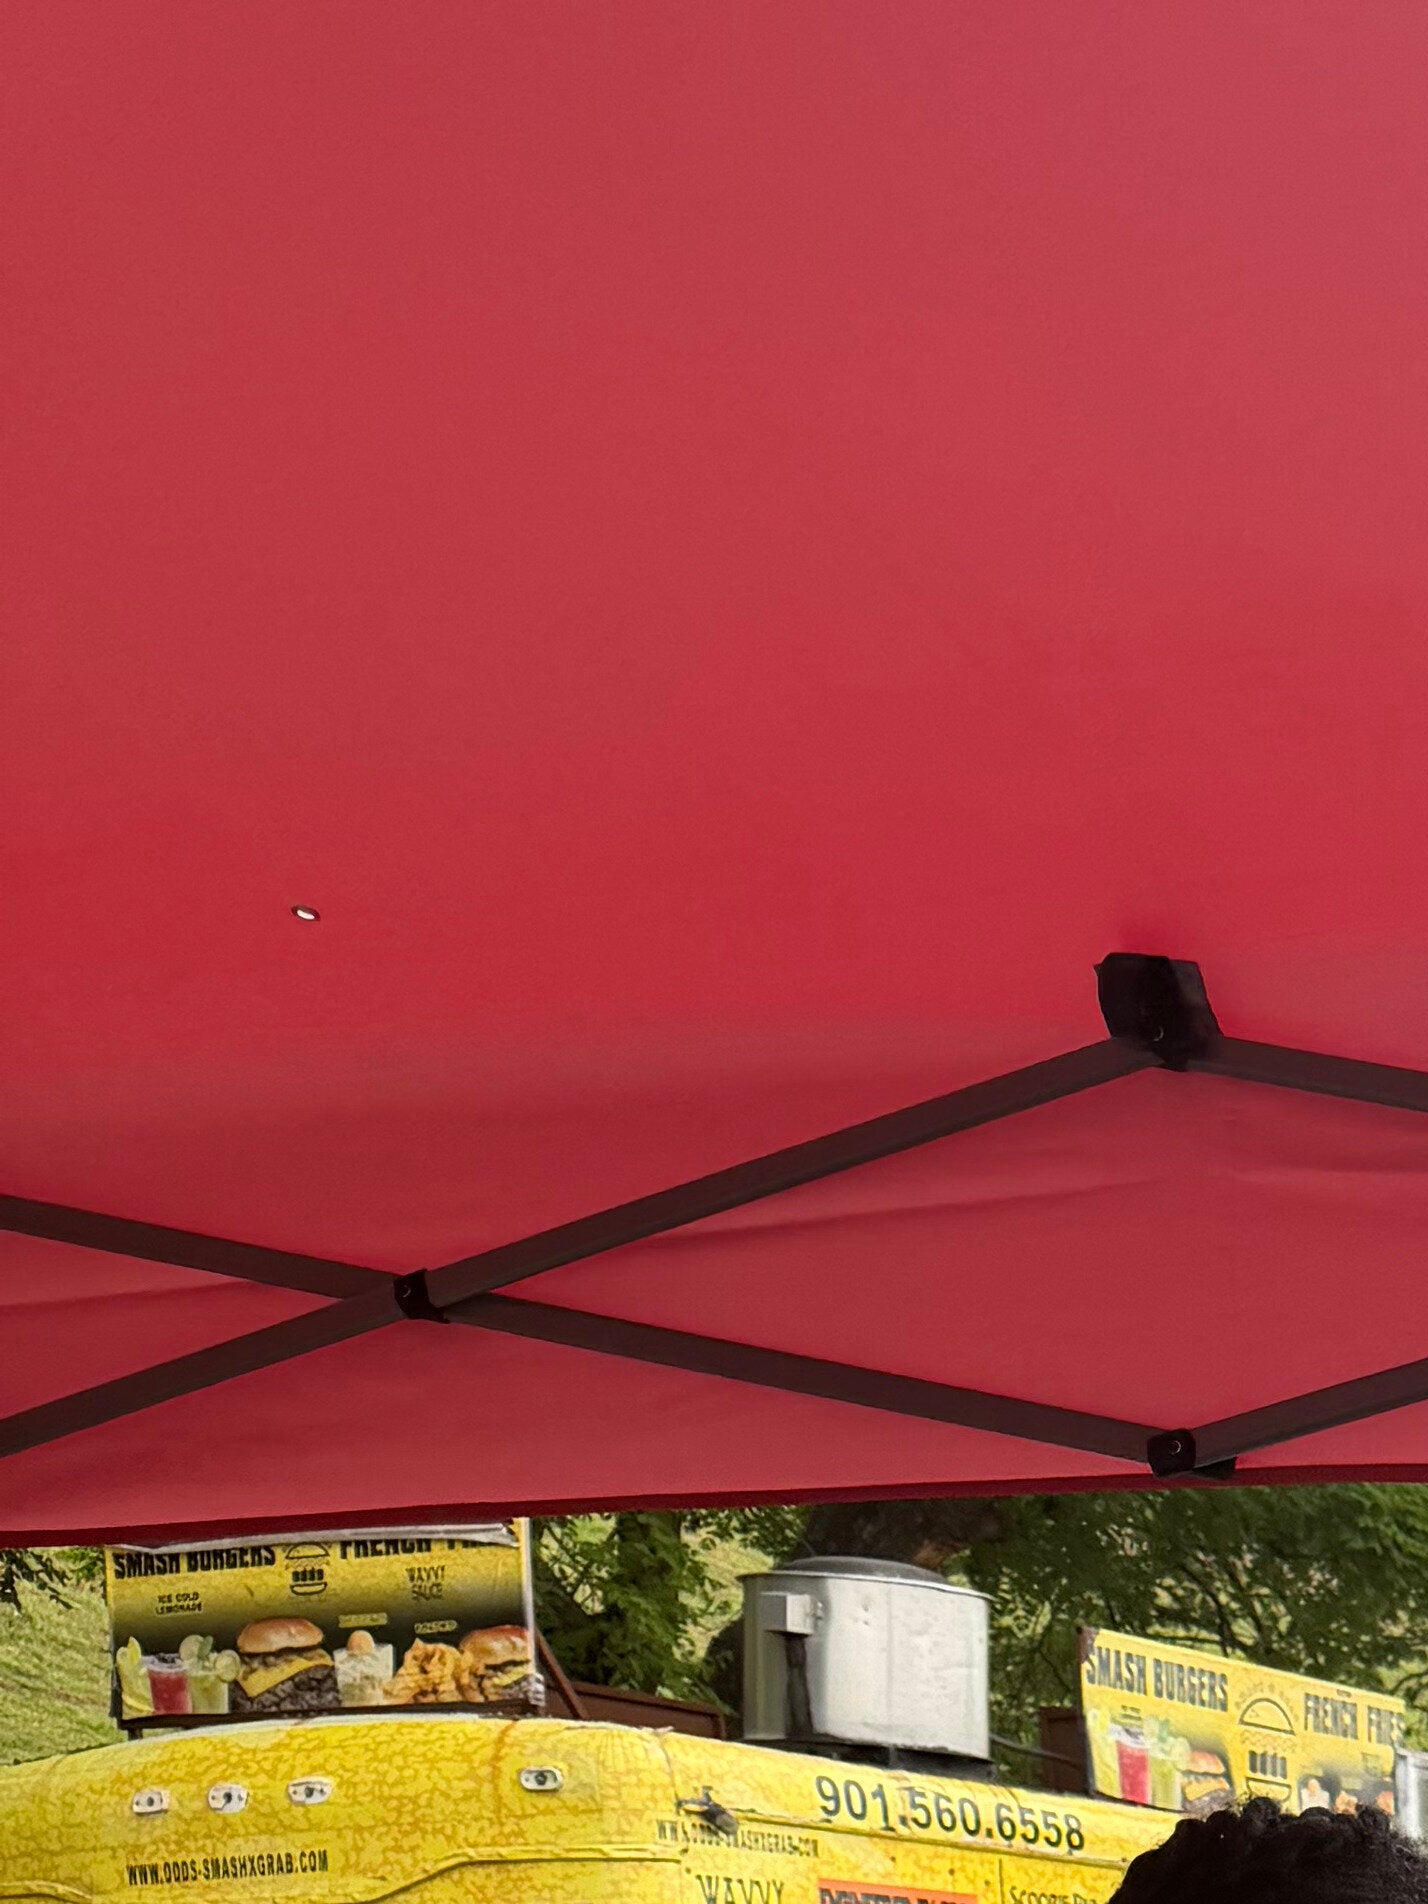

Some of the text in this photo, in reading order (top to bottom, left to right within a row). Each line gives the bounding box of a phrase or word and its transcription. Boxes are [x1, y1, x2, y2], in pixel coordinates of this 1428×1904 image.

[113, 1550, 181, 1579] SMASH
[157, 1591, 200, 1604] ICE COLD
[1085, 1646, 1148, 1696] SMASH
[1151, 1657, 1229, 1713] BURGERS
[814, 1775, 1086, 1851] 901.560.6558
